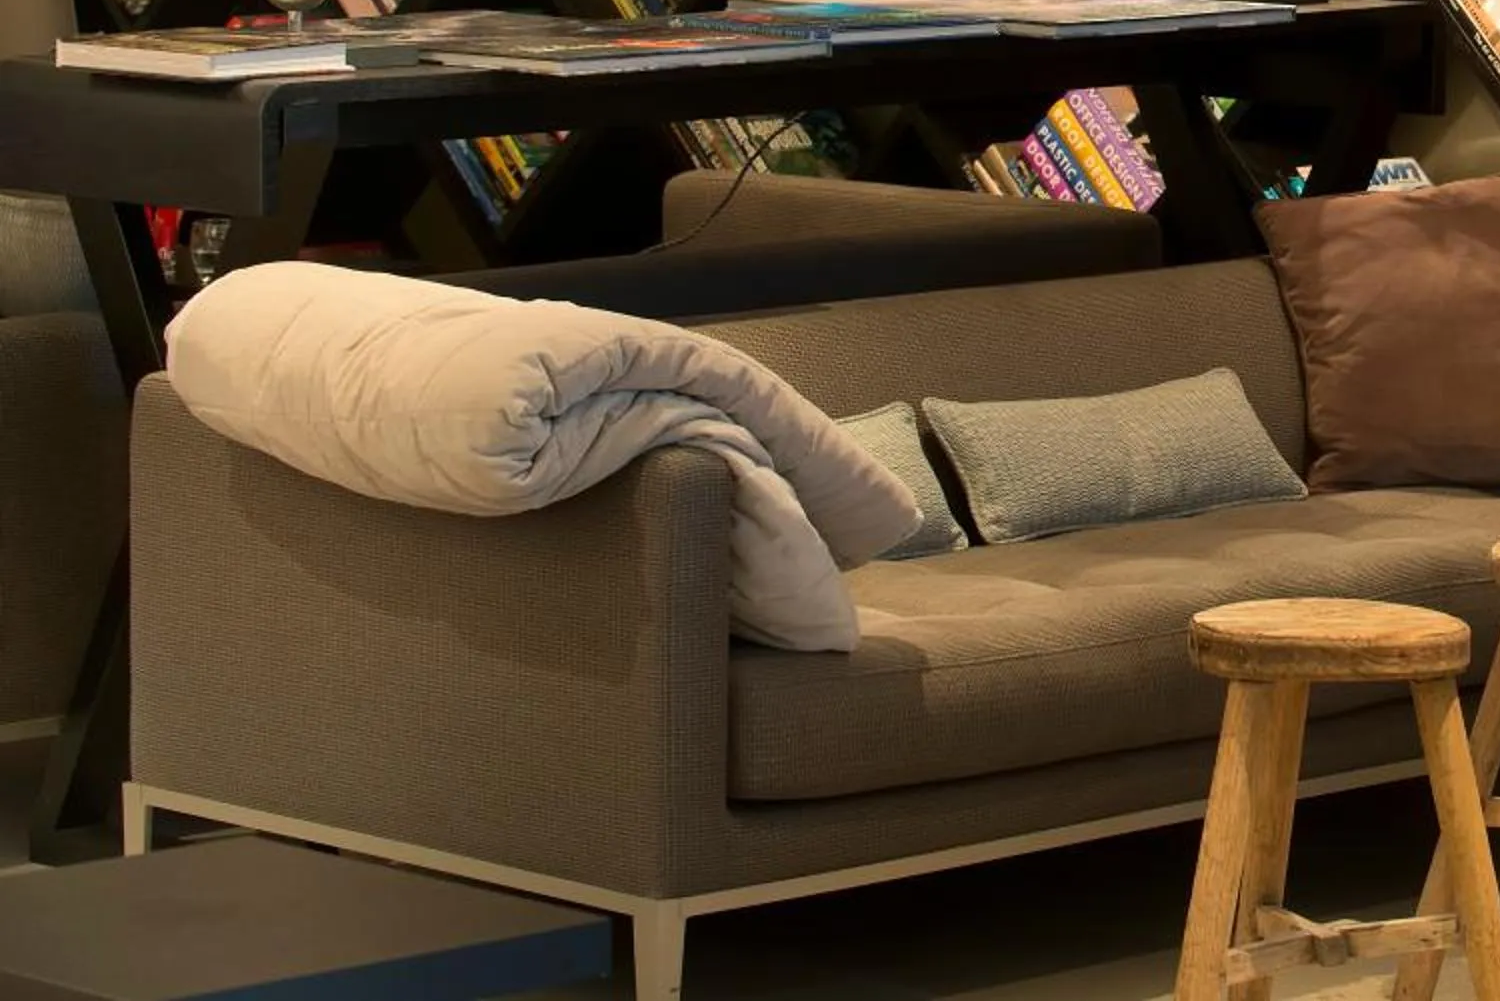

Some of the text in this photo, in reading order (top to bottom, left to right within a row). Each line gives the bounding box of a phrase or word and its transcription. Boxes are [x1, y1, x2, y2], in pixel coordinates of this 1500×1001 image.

[1021, 140, 1067, 188] DOOR
[1032, 124, 1081, 180] PLASTIC
[1065, 92, 1145, 202] OFFICE DESIGN
